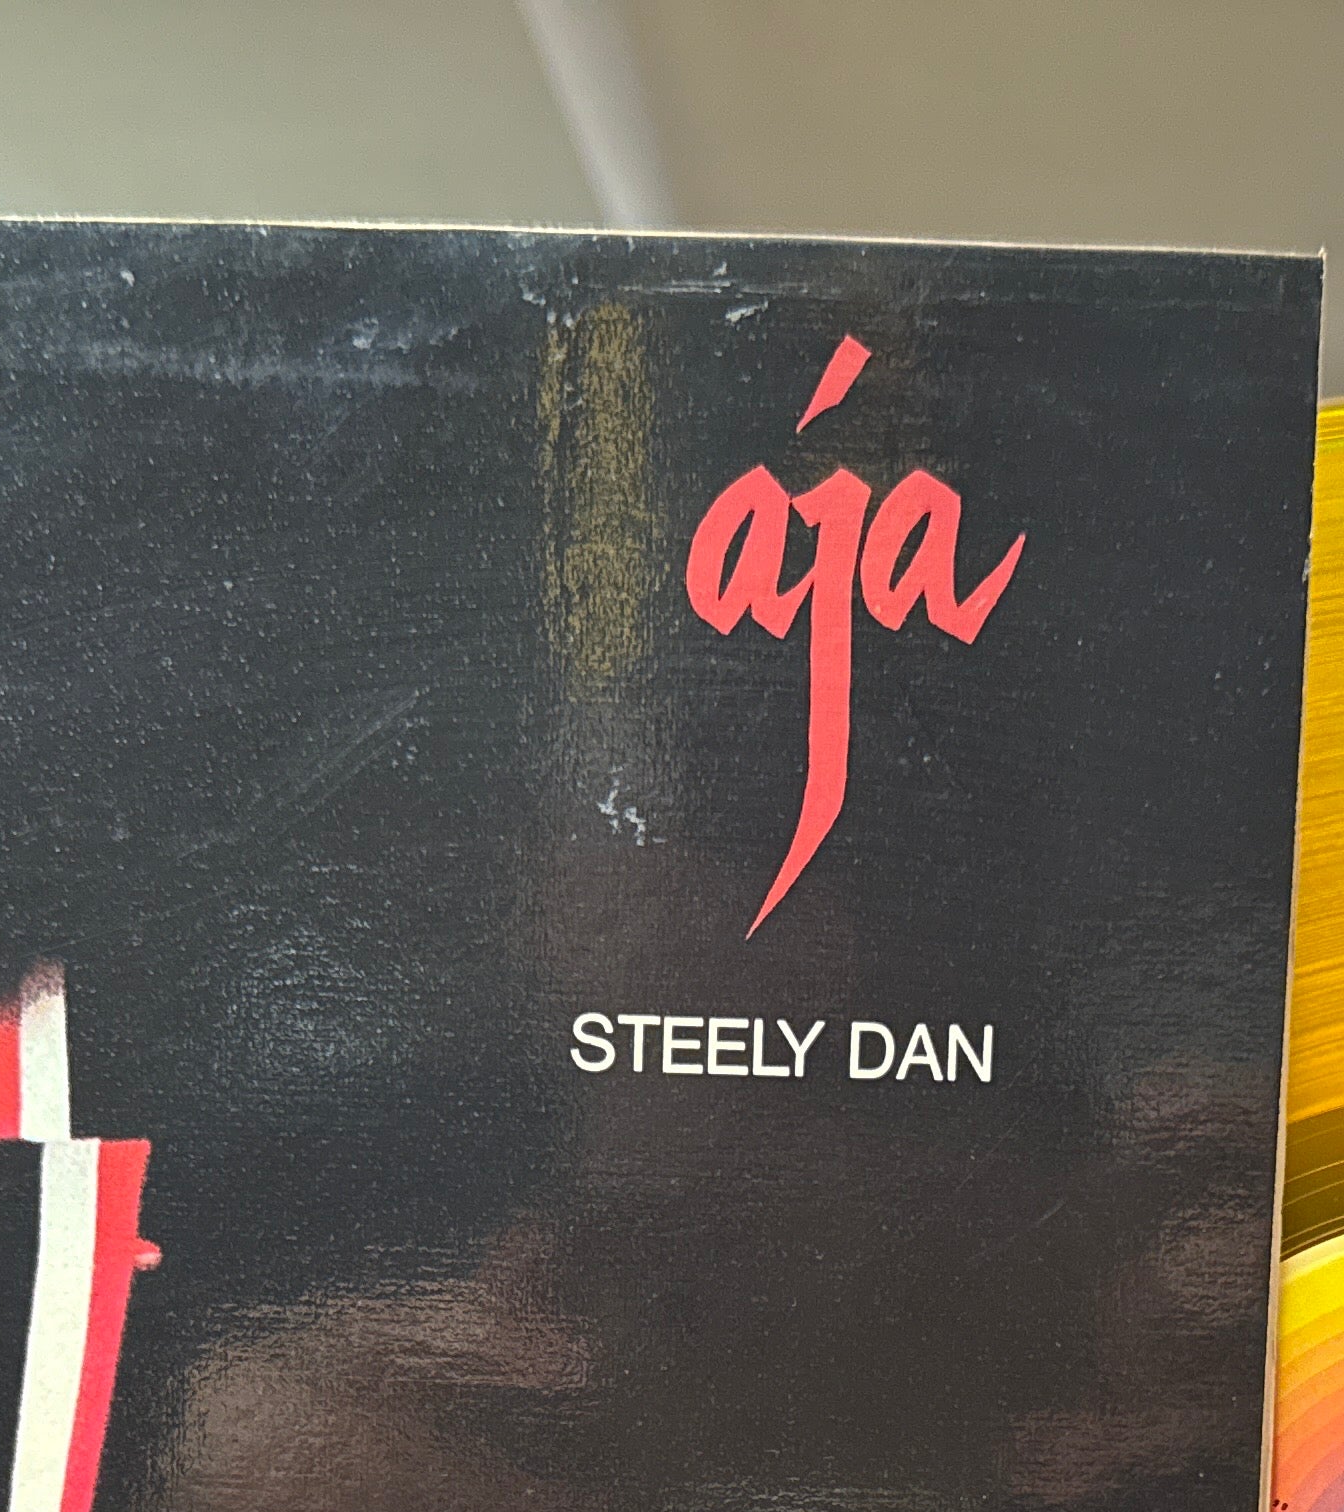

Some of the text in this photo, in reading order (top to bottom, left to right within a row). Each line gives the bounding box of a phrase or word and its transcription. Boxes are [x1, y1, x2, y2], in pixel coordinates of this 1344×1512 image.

[686, 334, 1026, 941] aja
[570, 1012, 994, 1083] STEELY DAN
